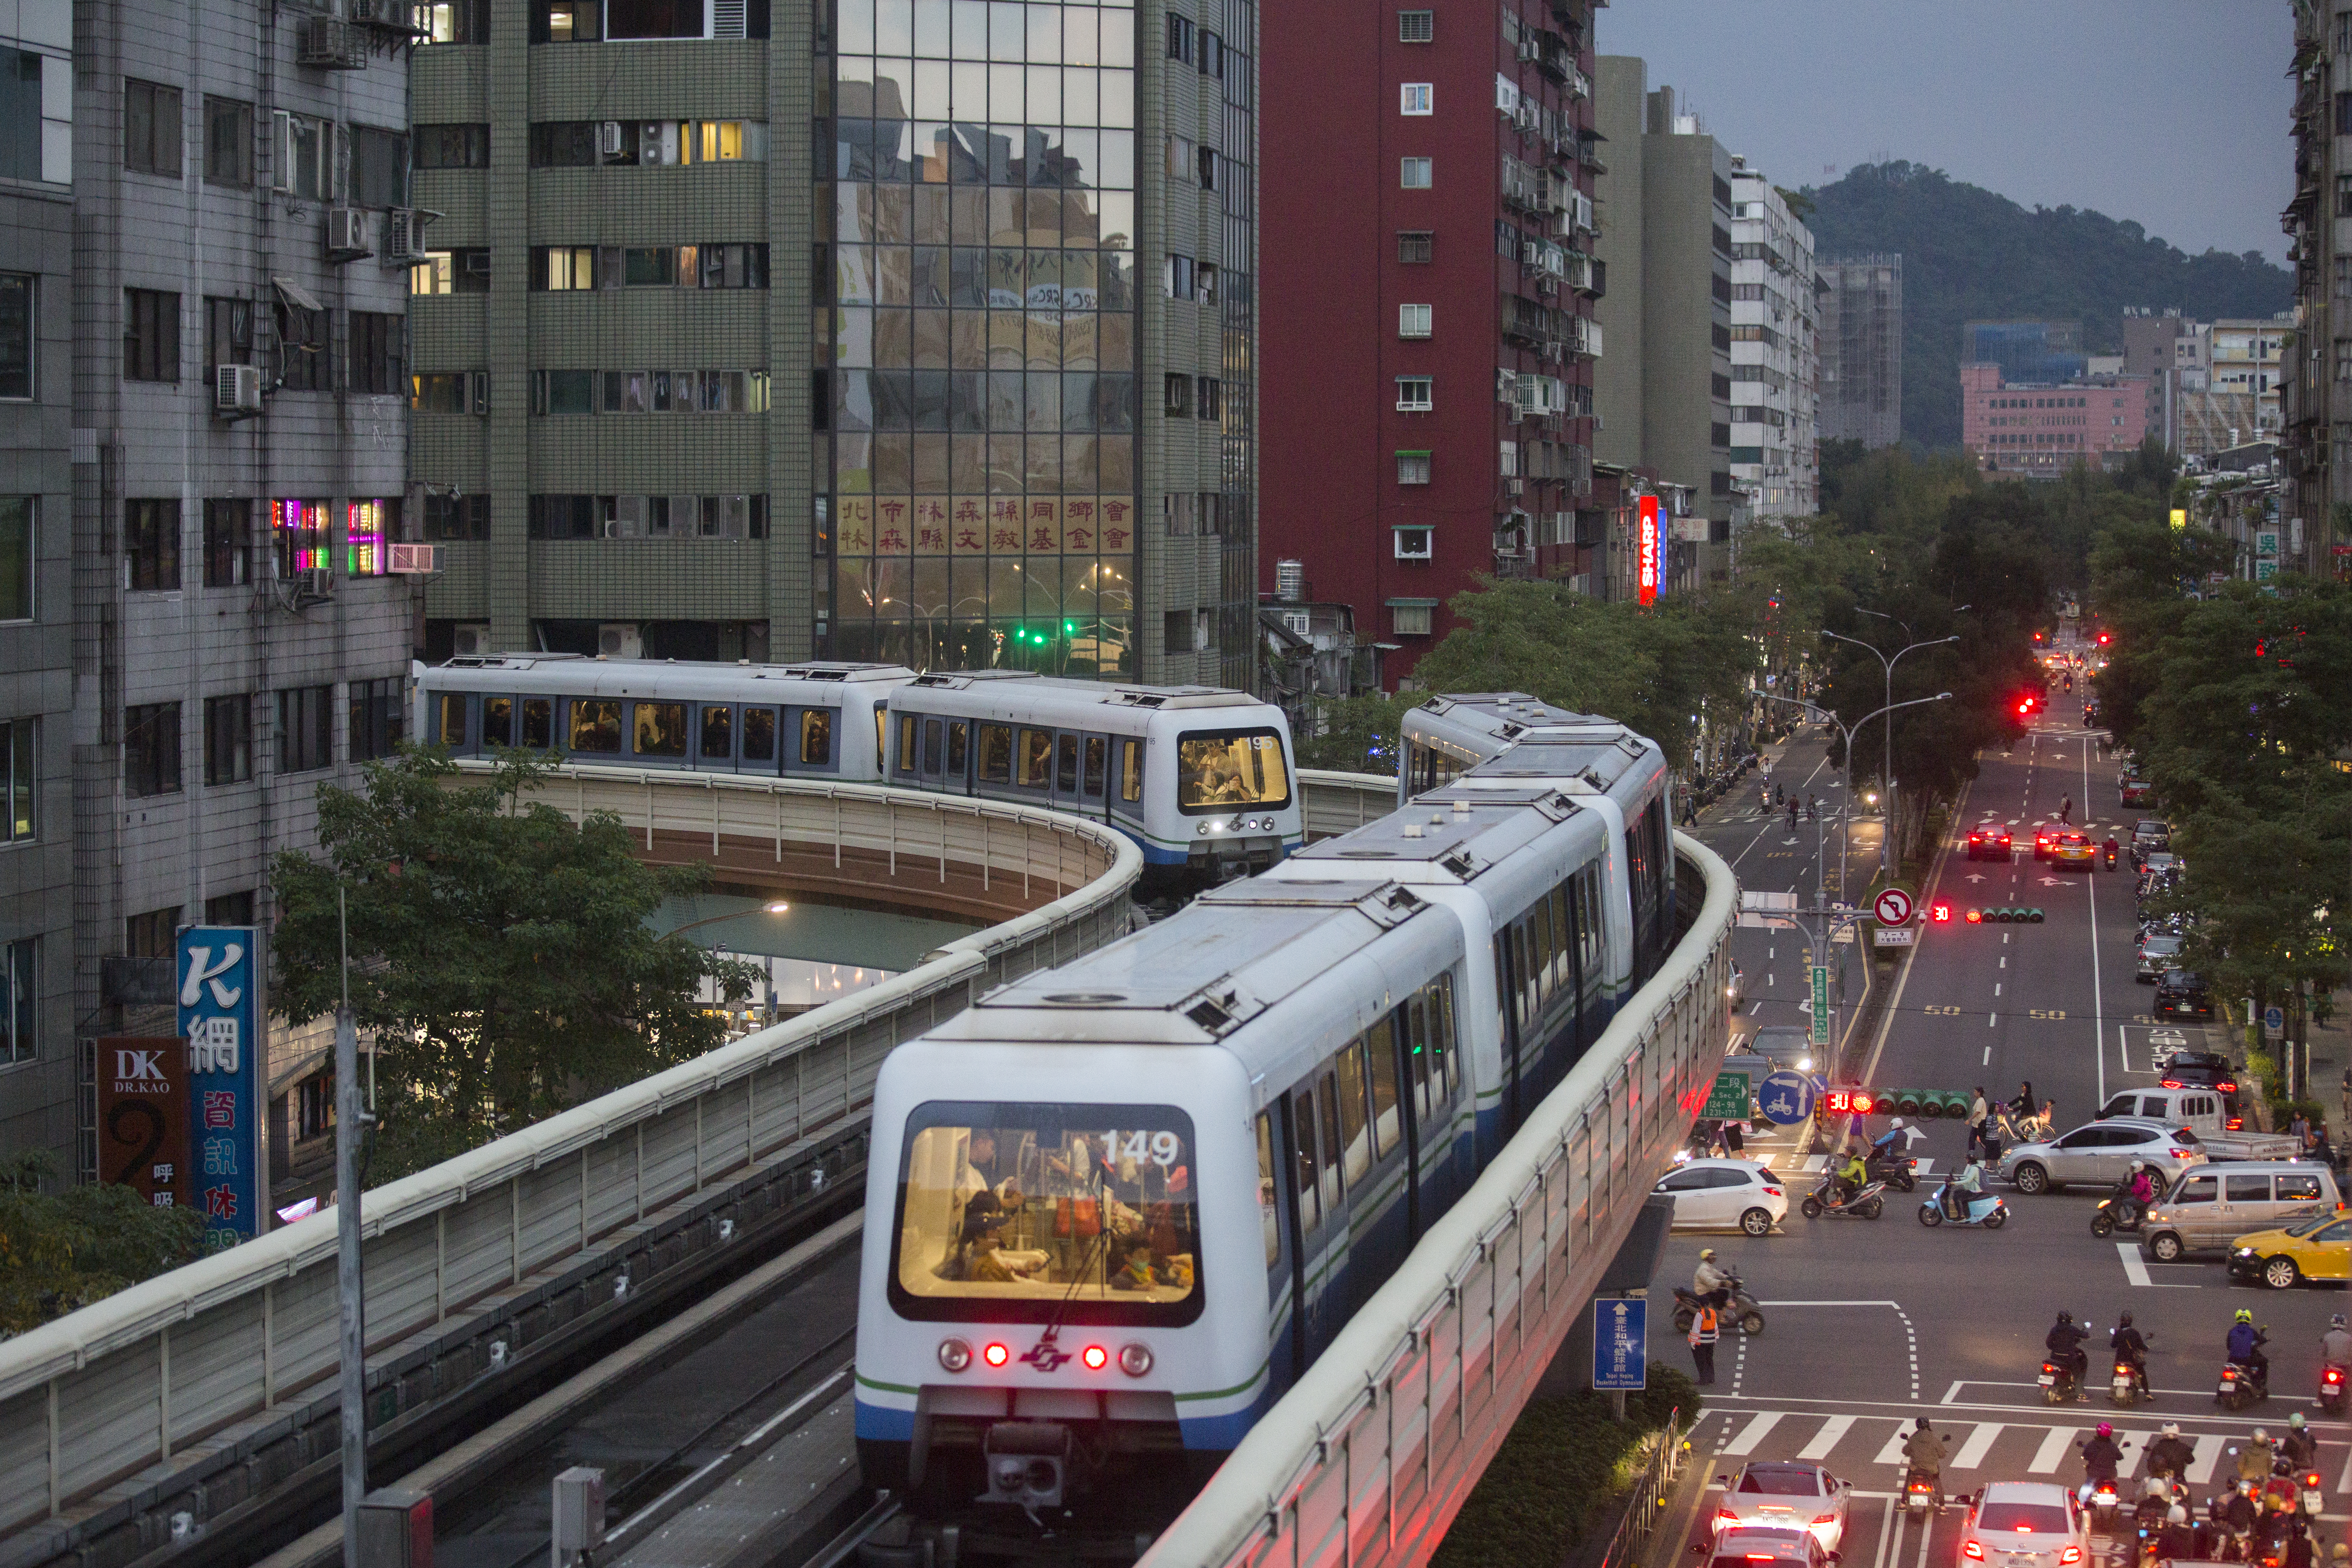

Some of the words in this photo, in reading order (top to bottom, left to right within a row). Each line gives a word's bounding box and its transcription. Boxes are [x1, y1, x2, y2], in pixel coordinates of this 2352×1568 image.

[1642, 515, 1654, 587] SHARP
[1246, 736, 1273, 751] 195
[1936, 907, 1948, 920] 30
[1924, 1005, 1961, 1015] 50
[2030, 1009, 2066, 1020] 50
[115, 1050, 167, 1080] DK
[115, 1082, 170, 1093] DR.KAO
[1101, 1129, 1178, 1165] 149
[154, 1163, 174, 1209] 呼吸
[1614, 1316, 1627, 1372] 臺北和平籃球館
